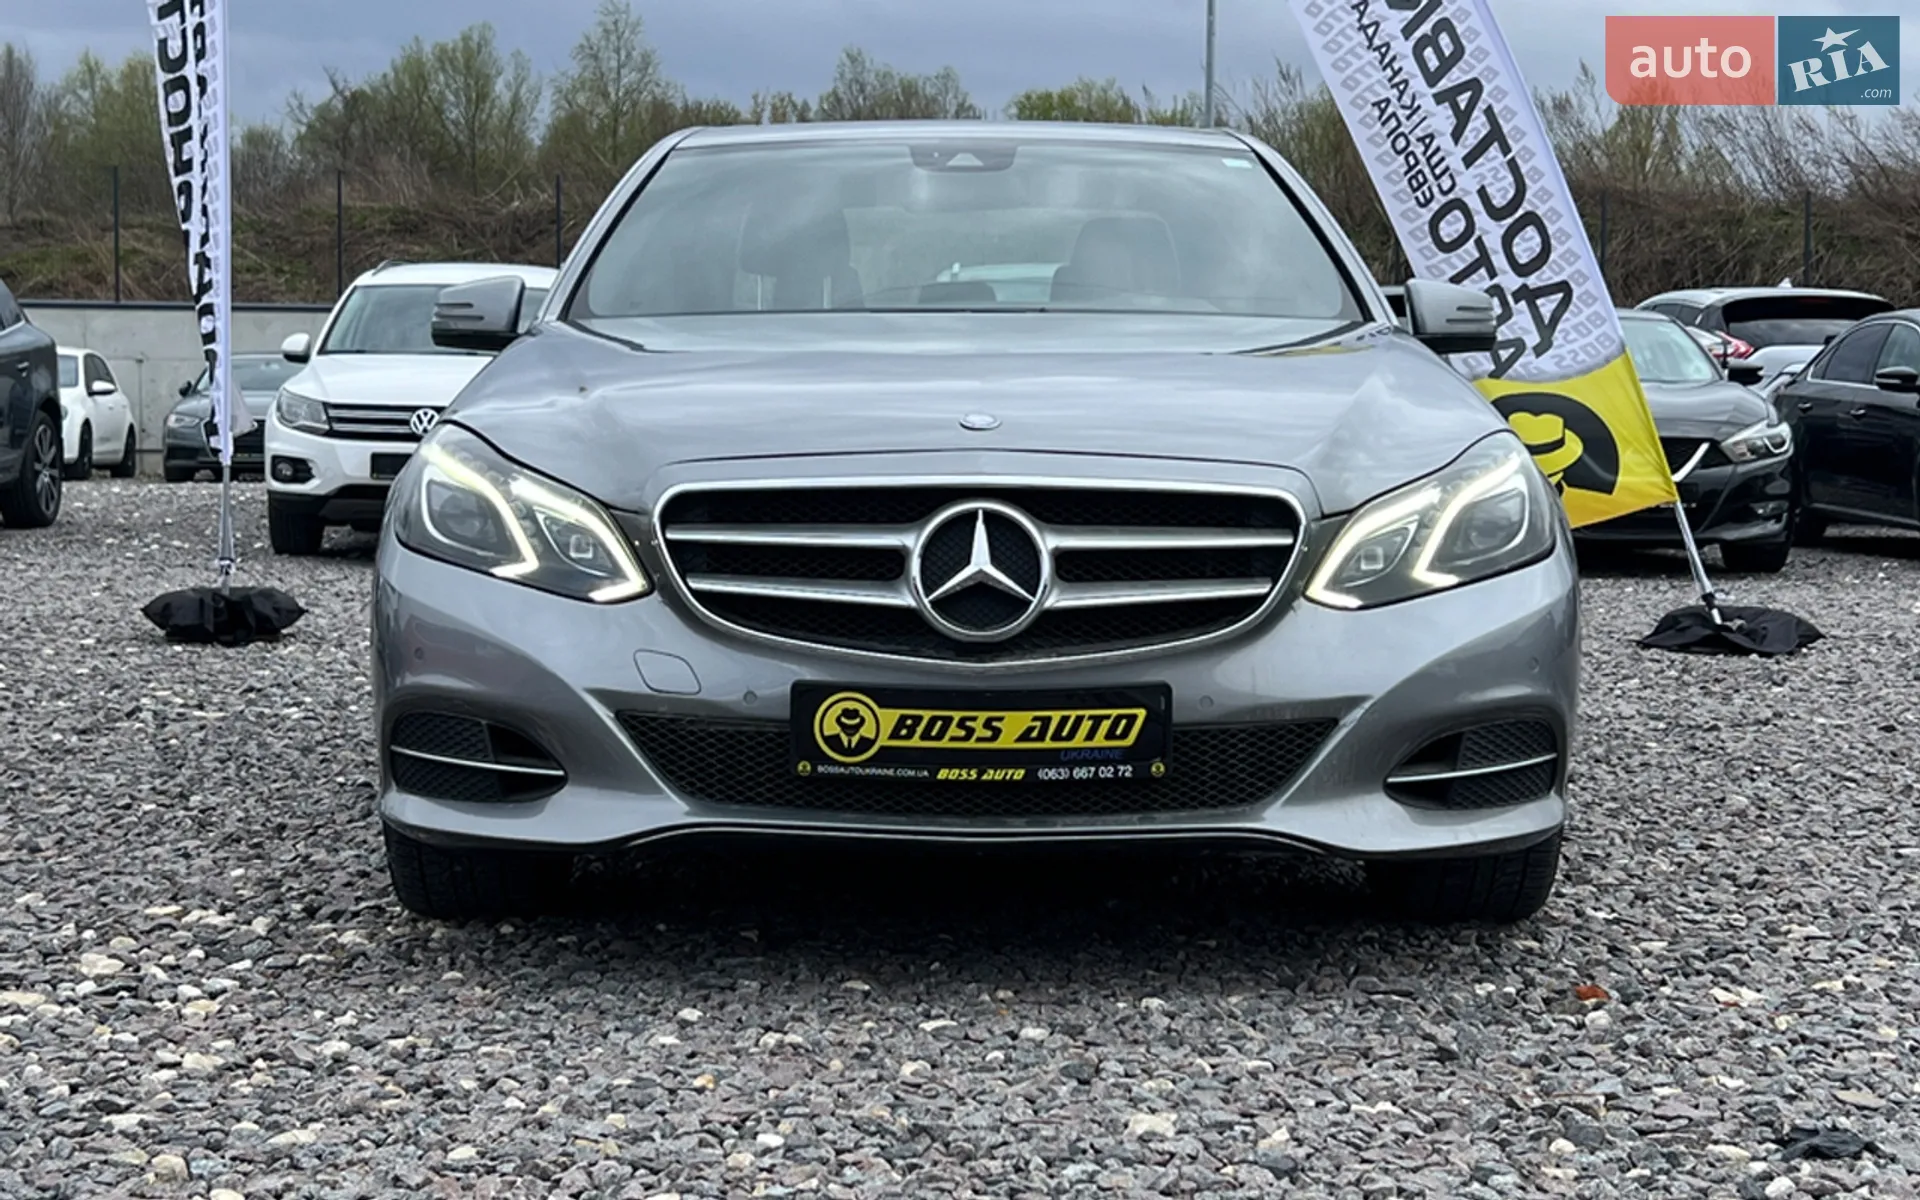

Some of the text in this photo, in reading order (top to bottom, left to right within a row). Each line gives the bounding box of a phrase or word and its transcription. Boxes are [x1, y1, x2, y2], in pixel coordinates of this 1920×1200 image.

[888, 712, 1140, 742] BOSS AUTO
[1059, 748, 1125, 762] UKRAINE
[936, 768, 1026, 780] BOSS AUTO
[1037, 765, 1133, 780] (063) 667 02 72
